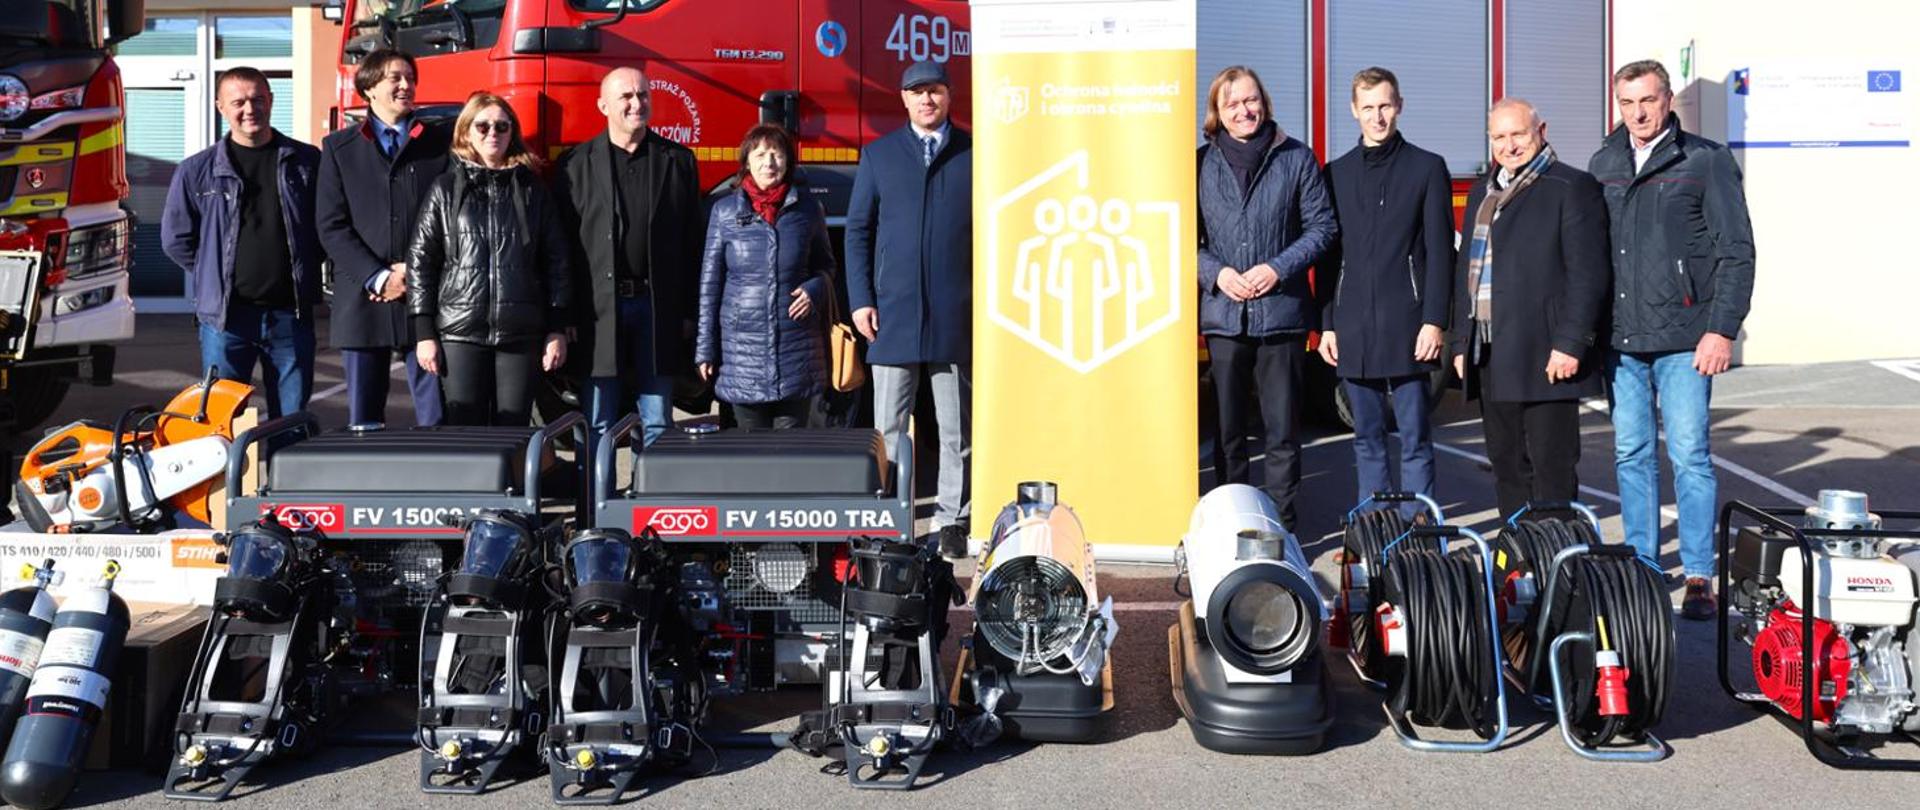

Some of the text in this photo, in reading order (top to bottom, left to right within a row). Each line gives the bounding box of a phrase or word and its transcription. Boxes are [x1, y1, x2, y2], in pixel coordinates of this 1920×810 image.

[885, 13, 969, 63] 469 M
[649, 79, 679, 96] STRAŻ
[651, 122, 692, 144] ACZÓW
[352, 507, 384, 525] FV
[726, 510, 758, 528] FV
[765, 509, 837, 528] 15000
[845, 510, 895, 528] TRA
[1, 545, 17, 556] TS
[1847, 576, 1892, 585] HONDA
